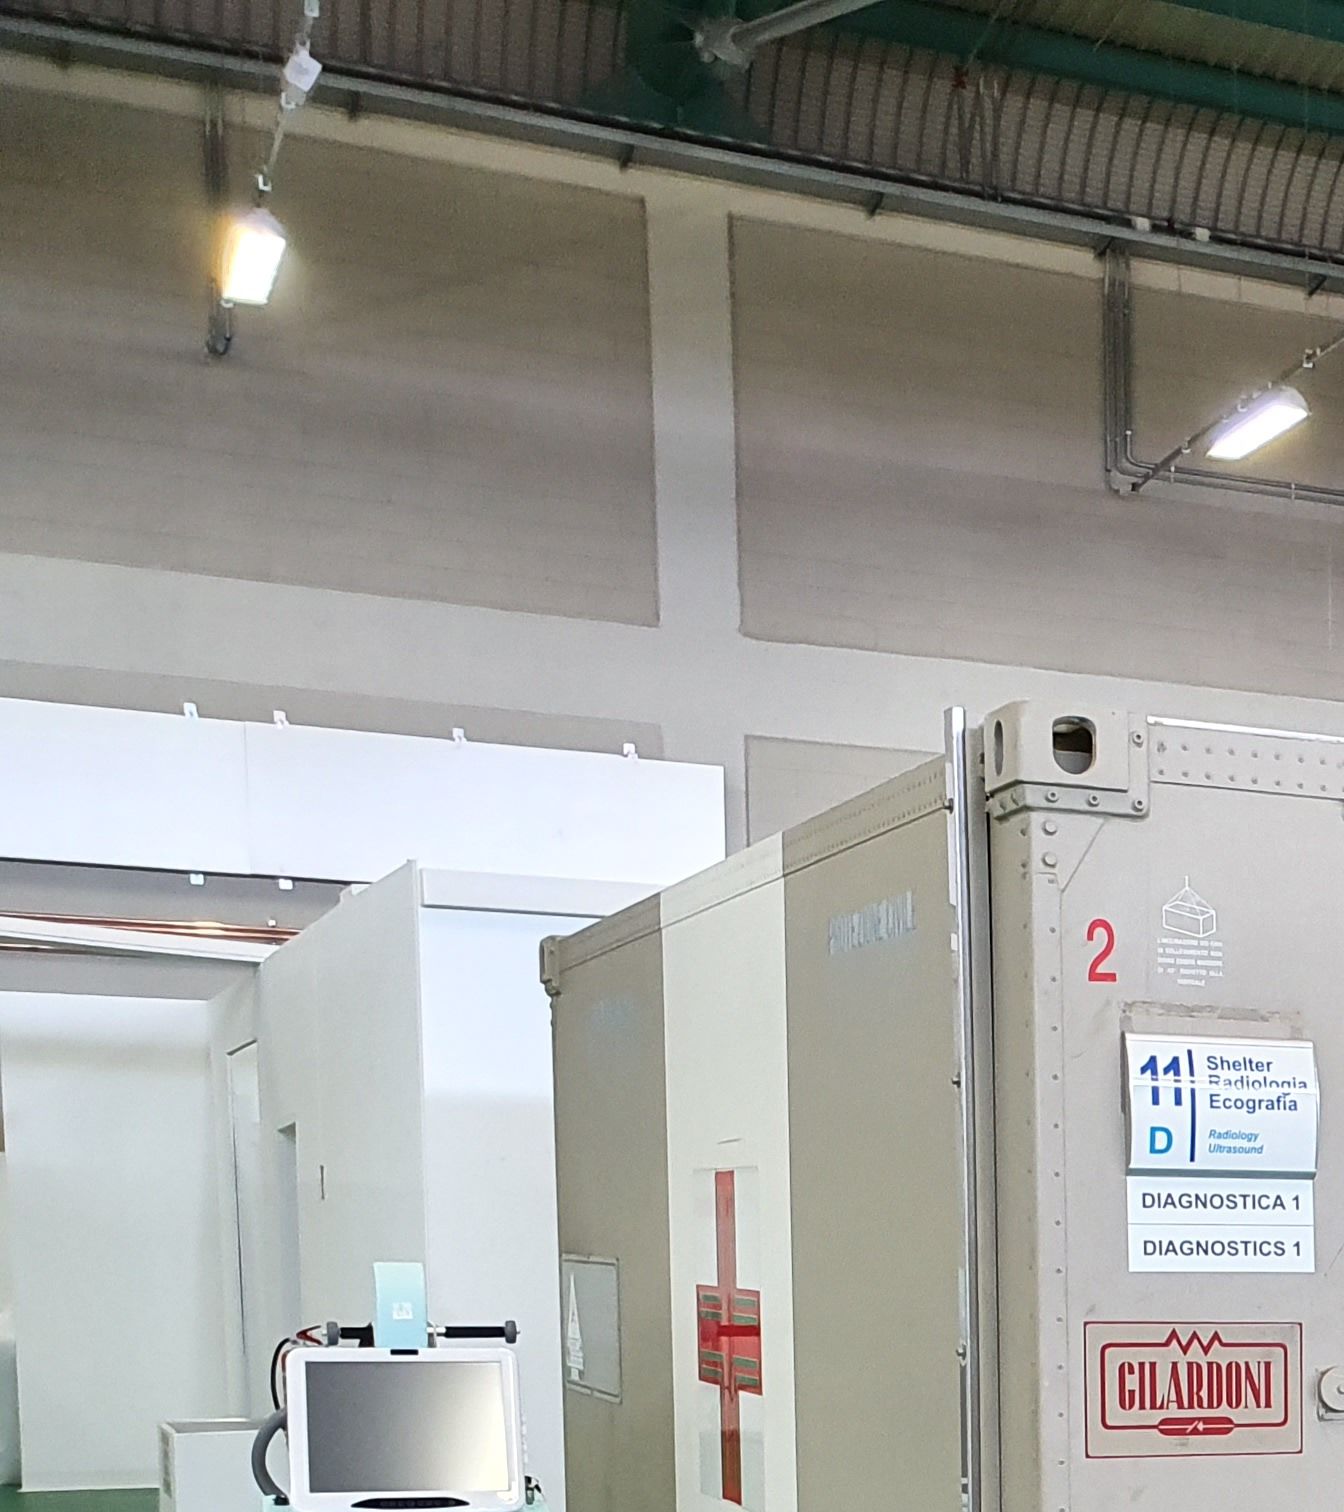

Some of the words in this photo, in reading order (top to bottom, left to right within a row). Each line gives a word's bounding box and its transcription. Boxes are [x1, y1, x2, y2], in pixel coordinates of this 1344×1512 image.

[1086, 917, 1118, 983] 2
[1206, 1055, 1274, 1073] Shelter
[1139, 1054, 1183, 1107] 11
[1208, 1092, 1299, 1114] Ecografia
[1148, 1126, 1174, 1154] D
[1208, 1128, 1261, 1143] Radiology
[1208, 1143, 1265, 1155] Ultrasound
[1141, 1192, 1287, 1211] DIAGNOSTICA
[1291, 1193, 1302, 1211] 1
[1142, 1239, 1287, 1258] DIAGNOSTICS
[1292, 1239, 1303, 1258] 1
[1117, 1360, 1274, 1411] GILARDONI
